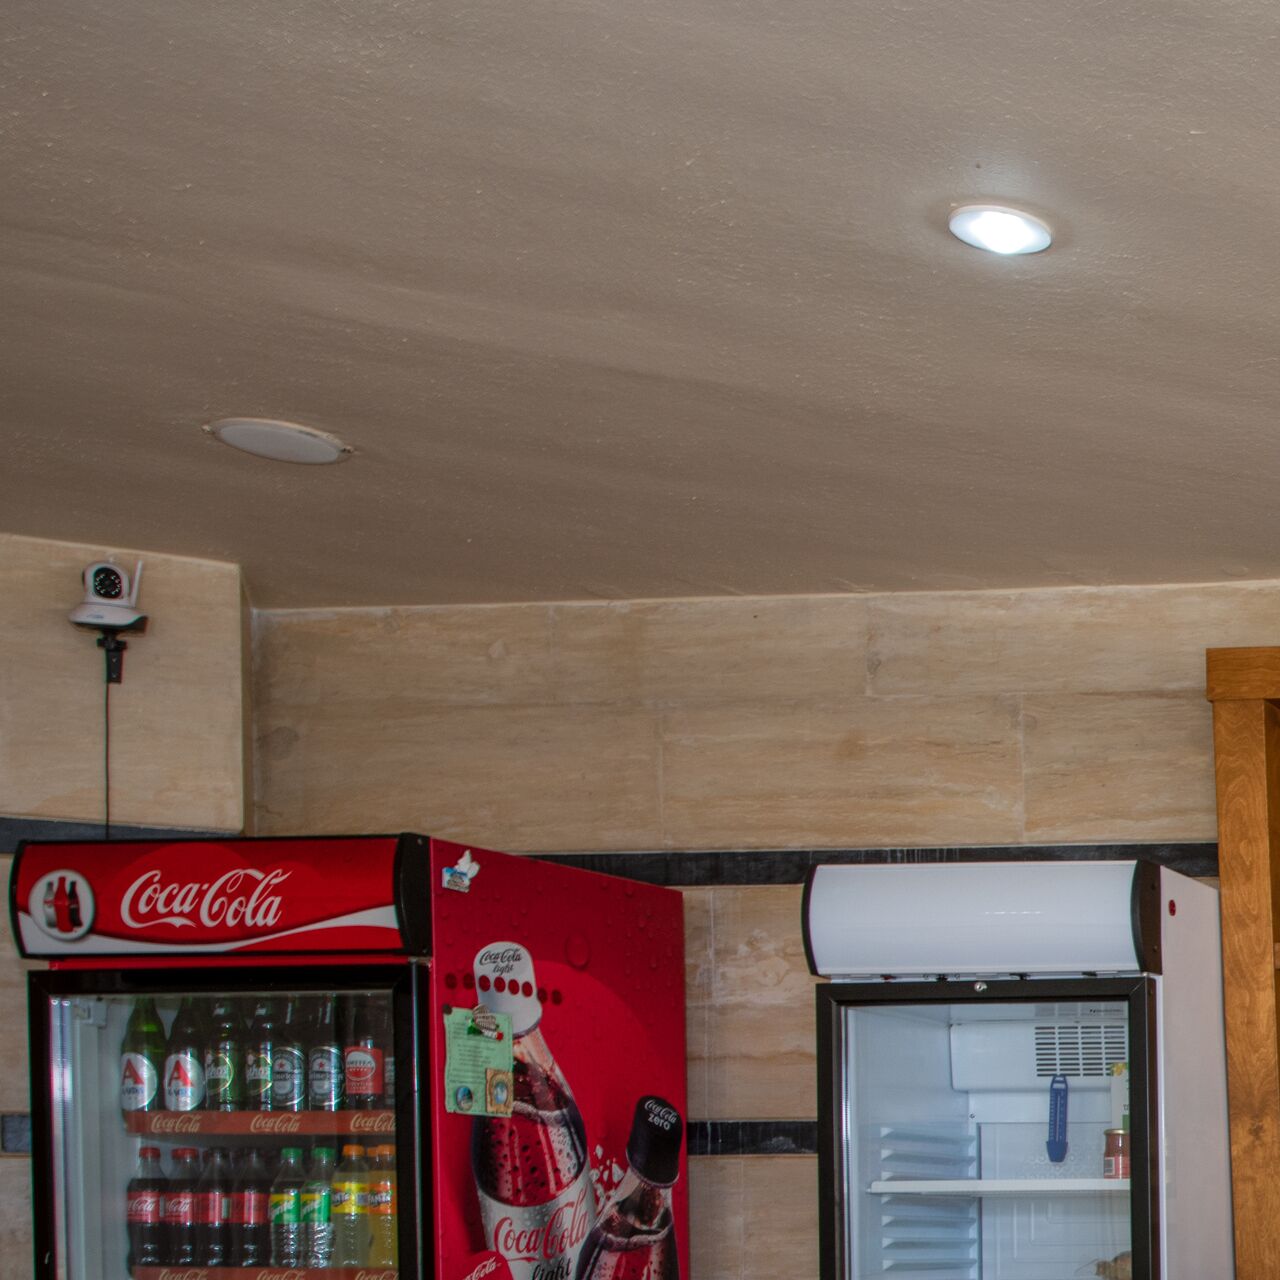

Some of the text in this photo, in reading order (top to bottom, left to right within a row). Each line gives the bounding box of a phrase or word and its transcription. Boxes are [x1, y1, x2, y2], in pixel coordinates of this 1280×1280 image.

[120, 869, 294, 928] Coca-Cola
[480, 948, 522, 966] Coca-Cola
[493, 963, 514, 976] light
[648, 1112, 671, 1131] zero
[493, 1188, 588, 1263] Coca-Cola
